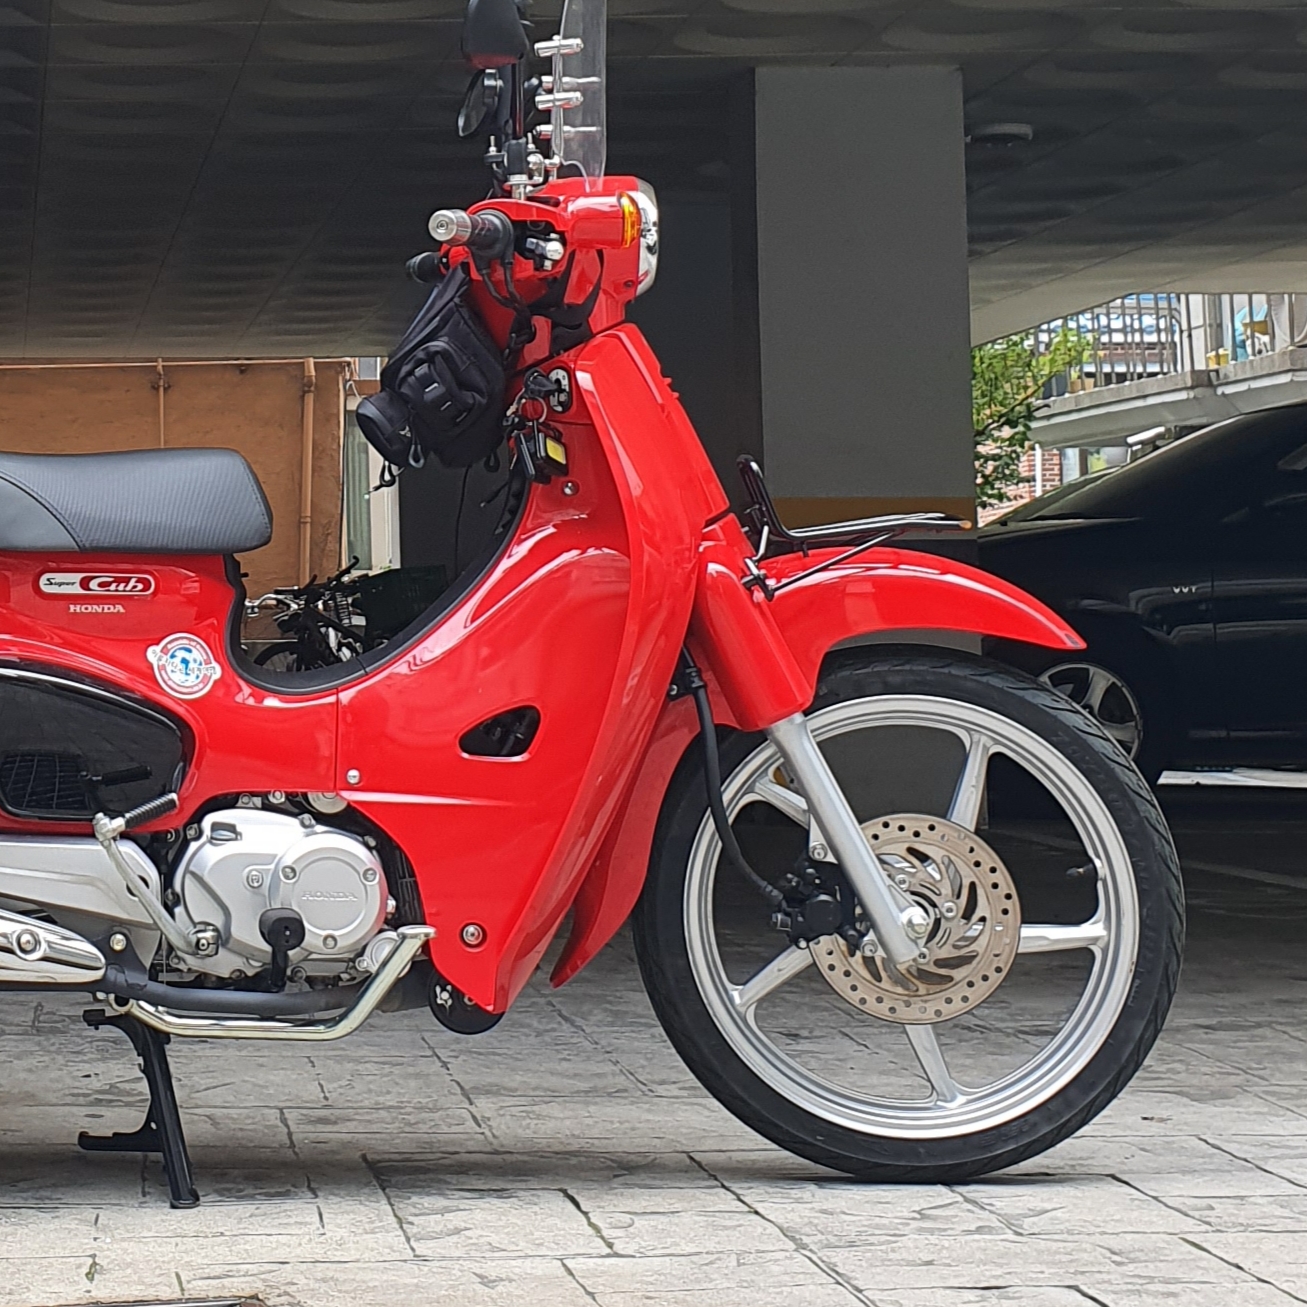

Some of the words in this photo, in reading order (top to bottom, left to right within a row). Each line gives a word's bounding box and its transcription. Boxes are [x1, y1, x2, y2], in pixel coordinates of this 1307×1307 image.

[43, 577, 77, 588] Super
[89, 576, 144, 591] Cub
[68, 604, 126, 613] HONDA
